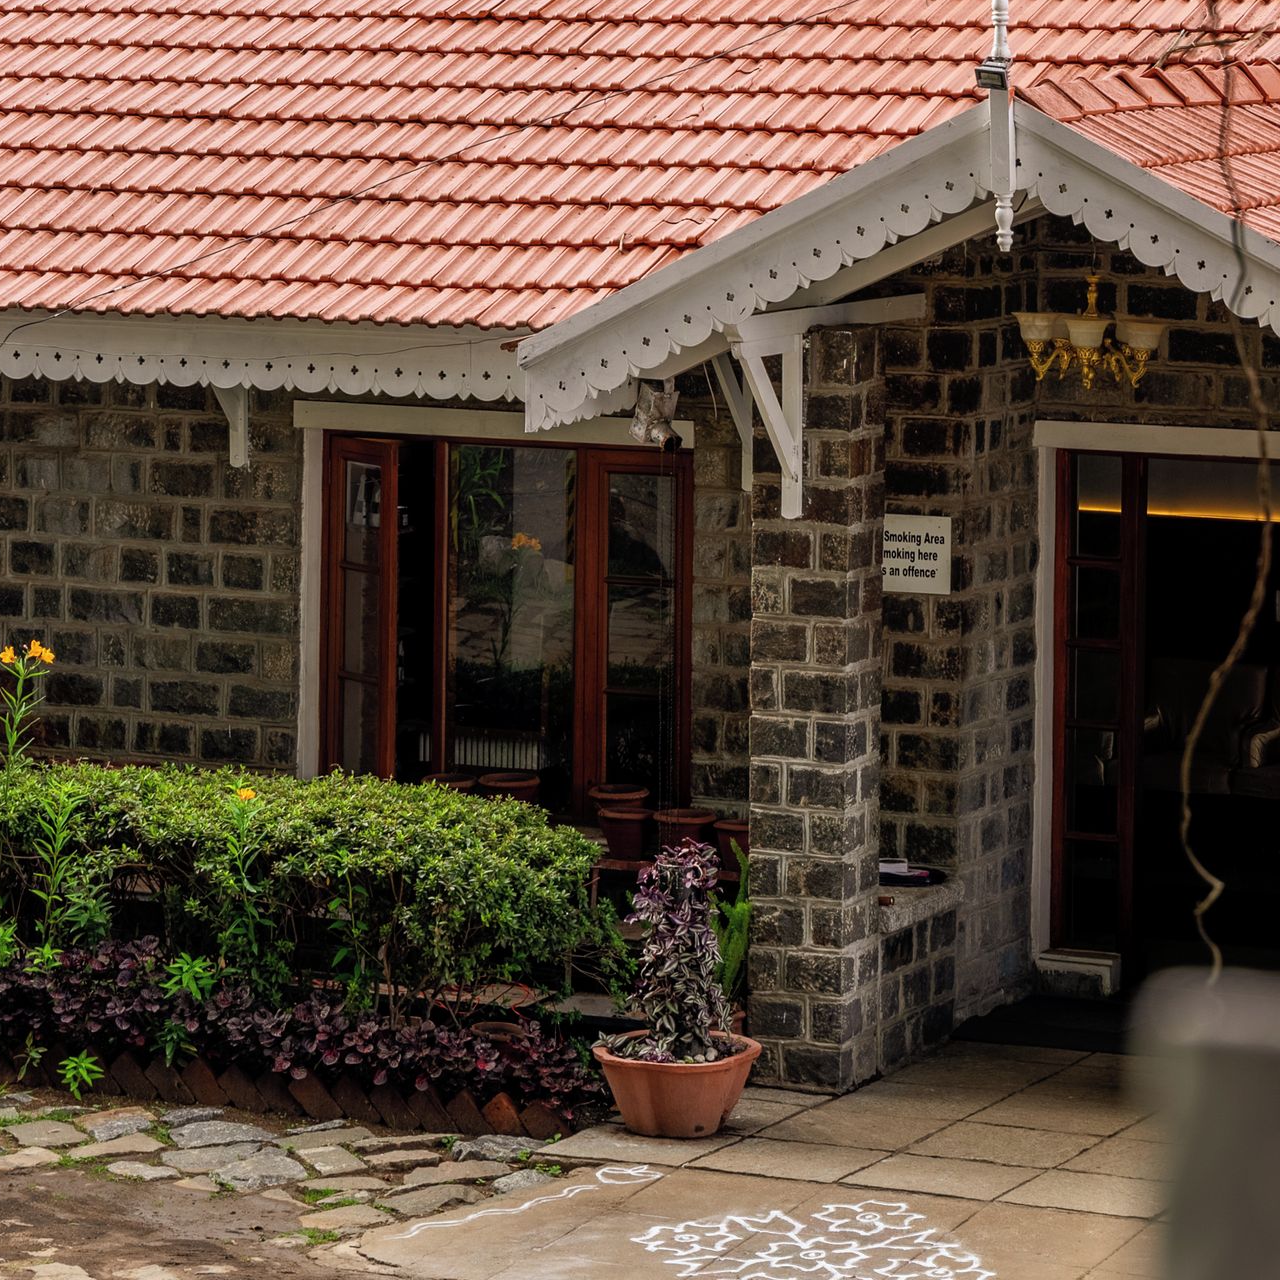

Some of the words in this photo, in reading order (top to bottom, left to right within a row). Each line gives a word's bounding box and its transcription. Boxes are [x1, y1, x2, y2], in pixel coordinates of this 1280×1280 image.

[884, 530, 922, 546] Smoking
[924, 532, 945, 545] Area
[883, 547, 915, 563] moking
[917, 549, 938, 561] here
[889, 567, 900, 577] an
